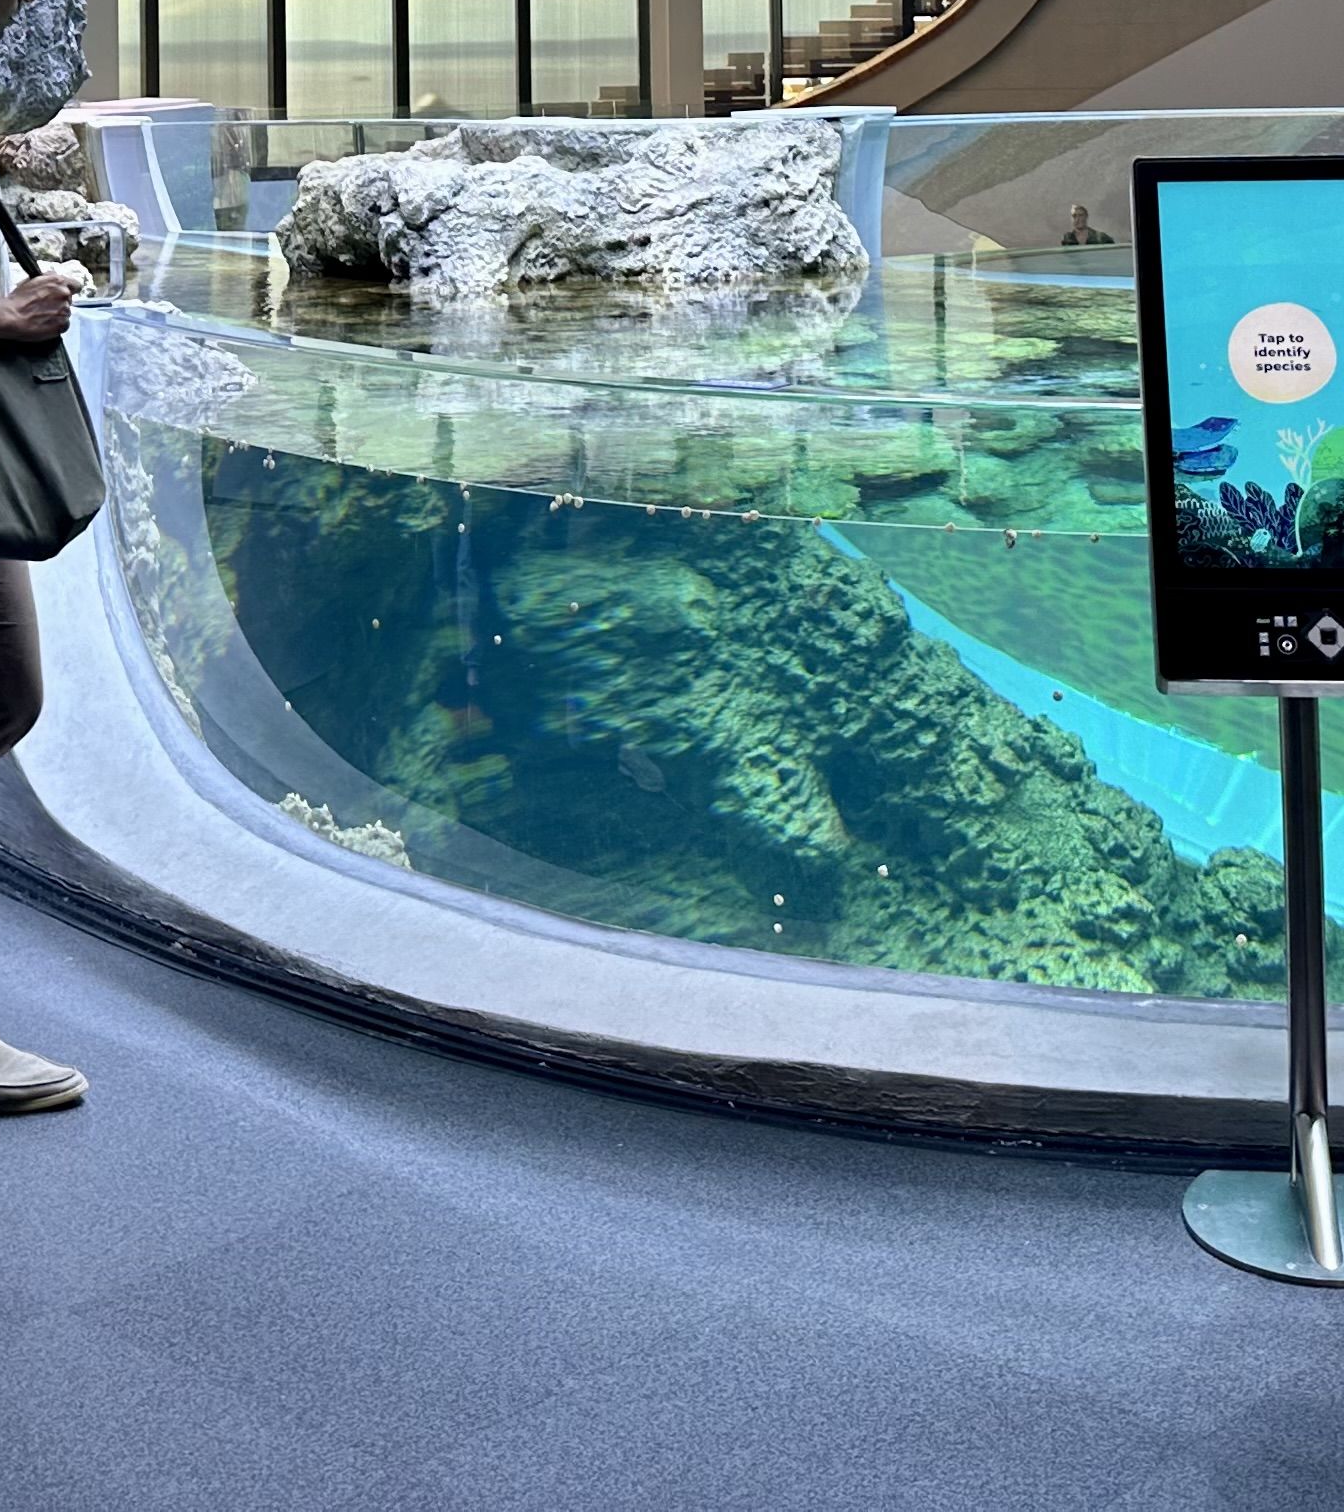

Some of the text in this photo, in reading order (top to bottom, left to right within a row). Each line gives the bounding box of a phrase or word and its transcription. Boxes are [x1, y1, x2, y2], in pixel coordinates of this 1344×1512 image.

[1258, 333, 1304, 345] Tap to
[1254, 346, 1311, 359] identify
[1256, 360, 1311, 373] species
